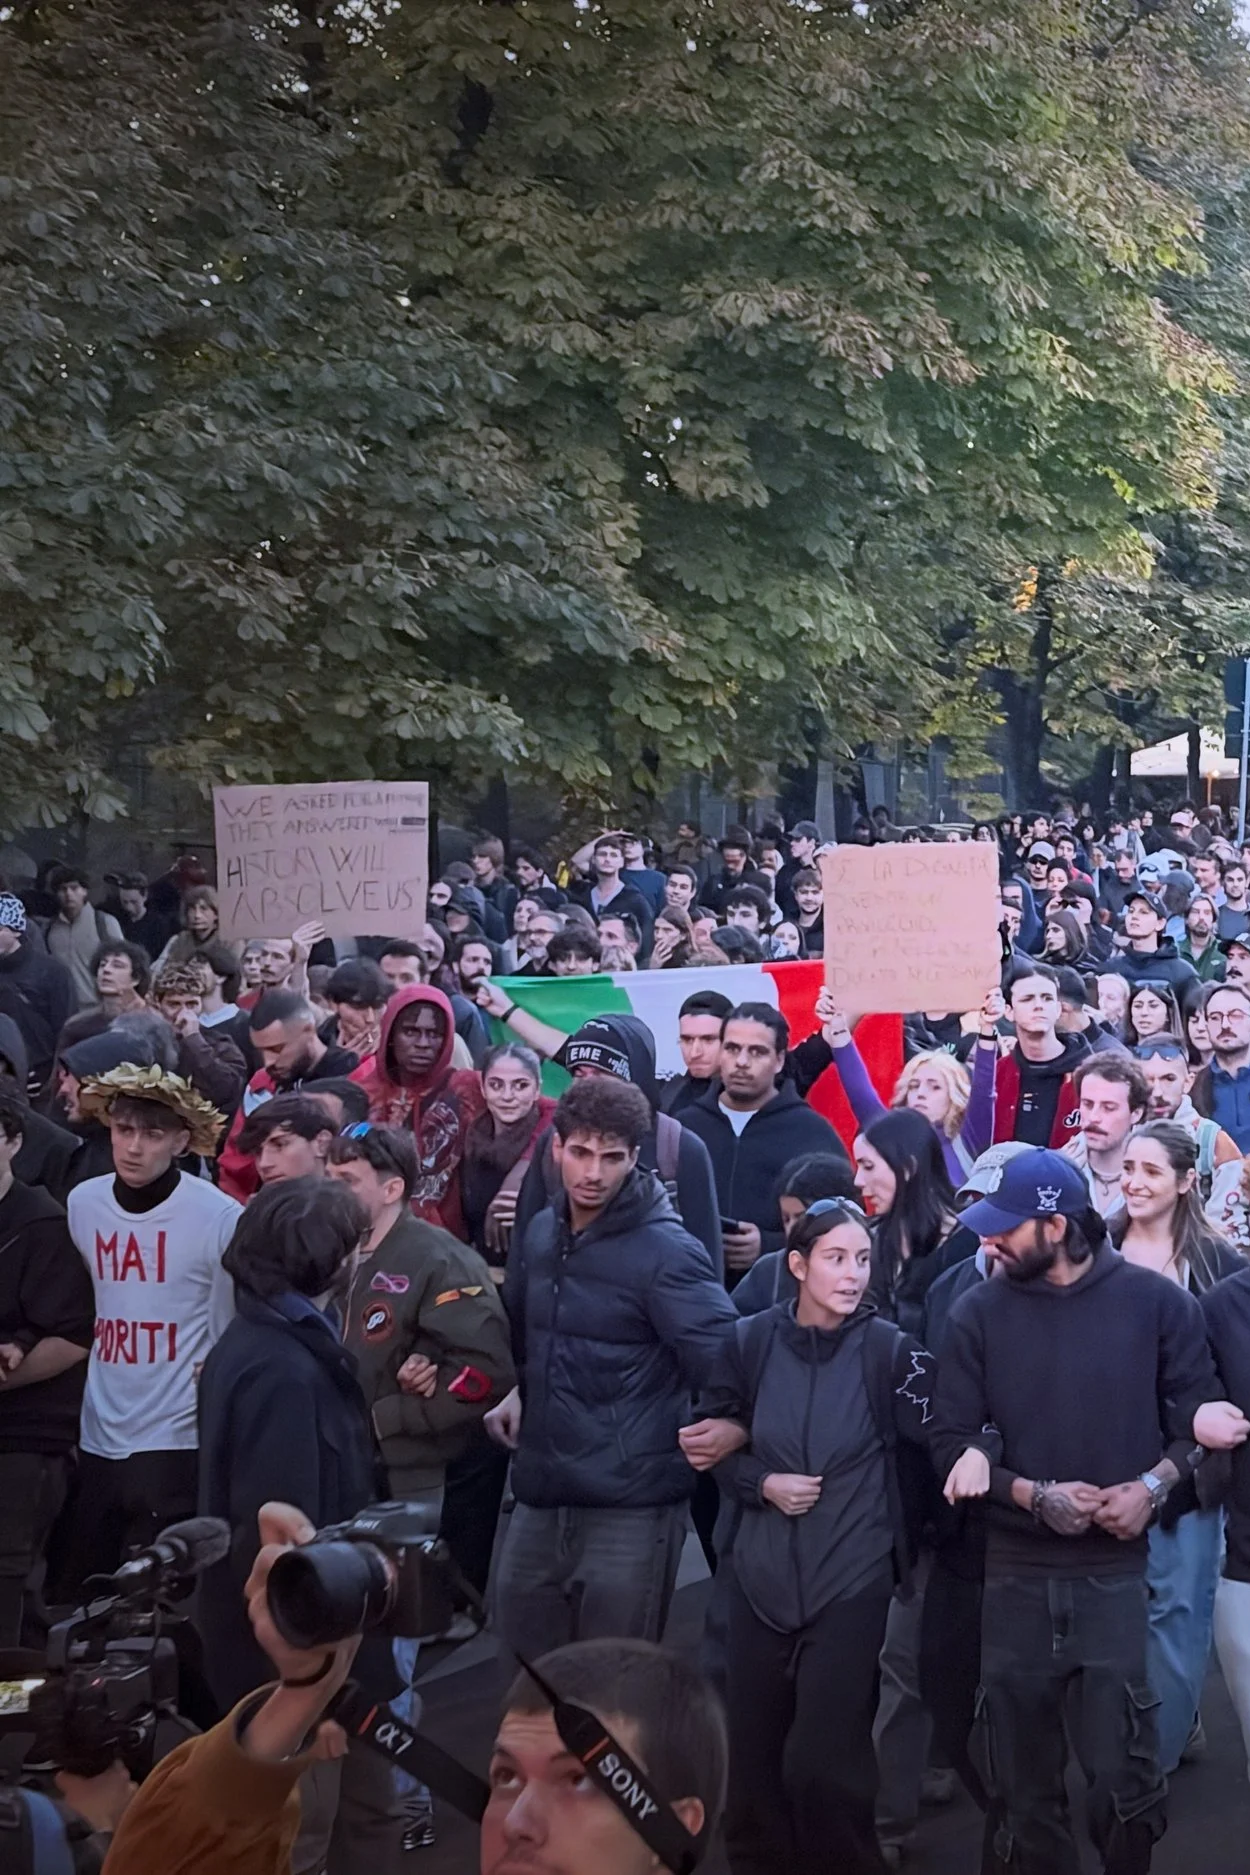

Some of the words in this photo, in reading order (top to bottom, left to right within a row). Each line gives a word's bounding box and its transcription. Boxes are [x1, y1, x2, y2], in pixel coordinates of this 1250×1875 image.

[219, 795, 273, 818] WE
[283, 793, 337, 813] ASKED
[226, 819, 278, 843] THEY
[328, 842, 386, 873] WILL
[232, 880, 380, 926] ABSOLVE
[95, 1228, 166, 1283] MAI
[598, 1752, 658, 1820] SONY
